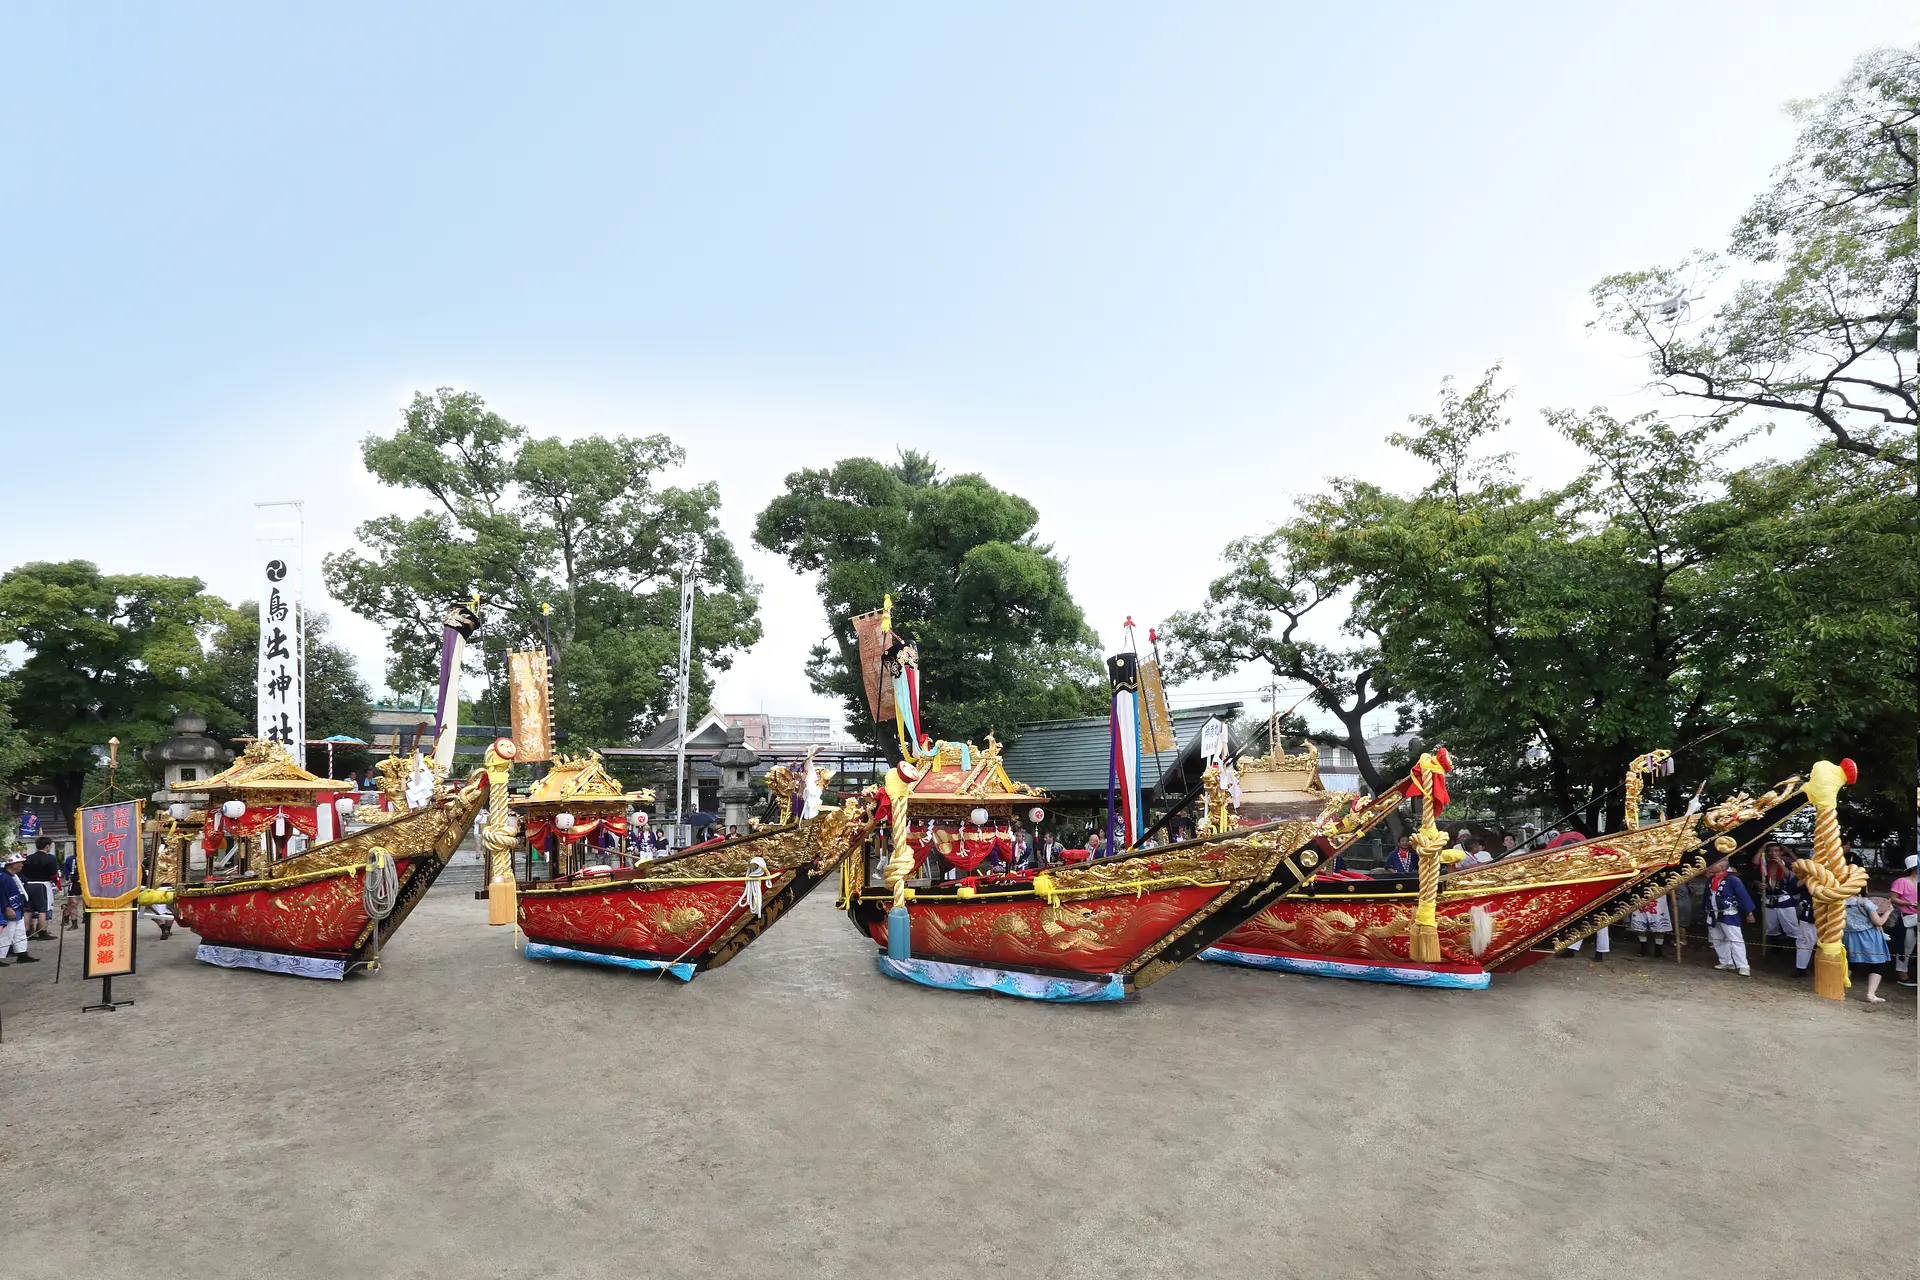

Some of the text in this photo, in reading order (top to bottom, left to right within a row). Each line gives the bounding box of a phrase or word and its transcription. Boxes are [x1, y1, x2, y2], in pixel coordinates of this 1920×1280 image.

[267, 587, 294, 745] 鳥出神社
[91, 811, 107, 833] 元祖
[97, 832, 129, 887] 古川町
